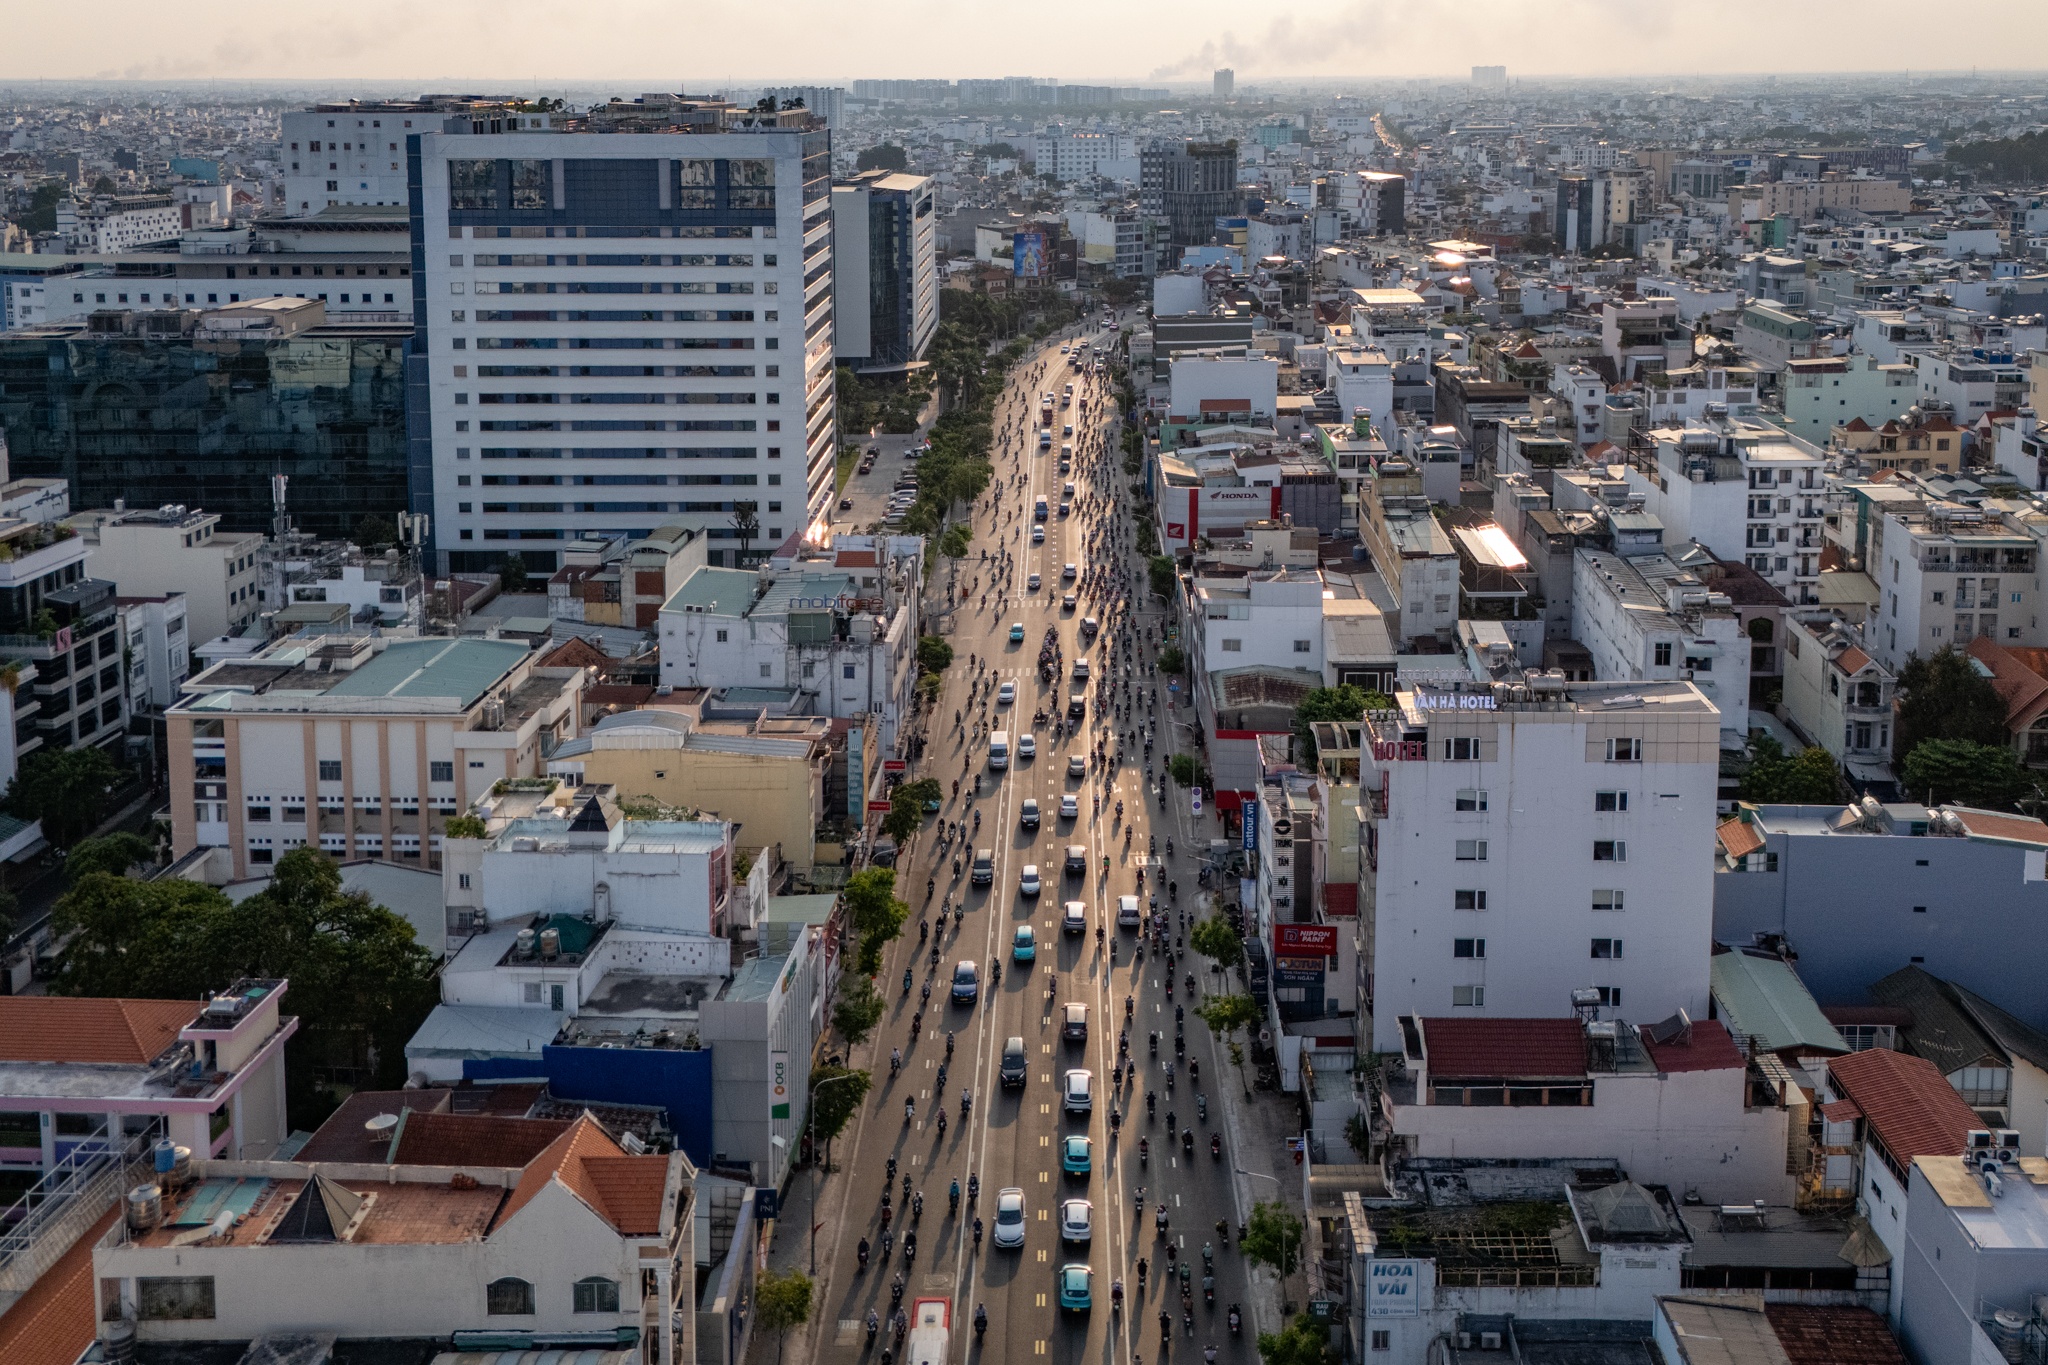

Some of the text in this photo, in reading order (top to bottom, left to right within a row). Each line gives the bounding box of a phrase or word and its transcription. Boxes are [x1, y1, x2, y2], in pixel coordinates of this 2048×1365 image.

[789, 594, 883, 609] mobifone
[1440, 693, 1457, 709] HÀ
[1460, 695, 1497, 710] HOTEL
[1374, 741, 1427, 761] HOTEL
[1245, 803, 1254, 848] cattour.vn
[1275, 839, 1292, 848] TRUNG
[1278, 856, 1289, 866] TÂM
[1289, 959, 1321, 969] JOTUN
[775, 1062, 784, 1085] OCB
[760, 1205, 773, 1213] PNJ
[1373, 1264, 1412, 1276] HOA
[1377, 1279, 1407, 1295] VẢI
[1371, 1307, 1388, 1315] 430
